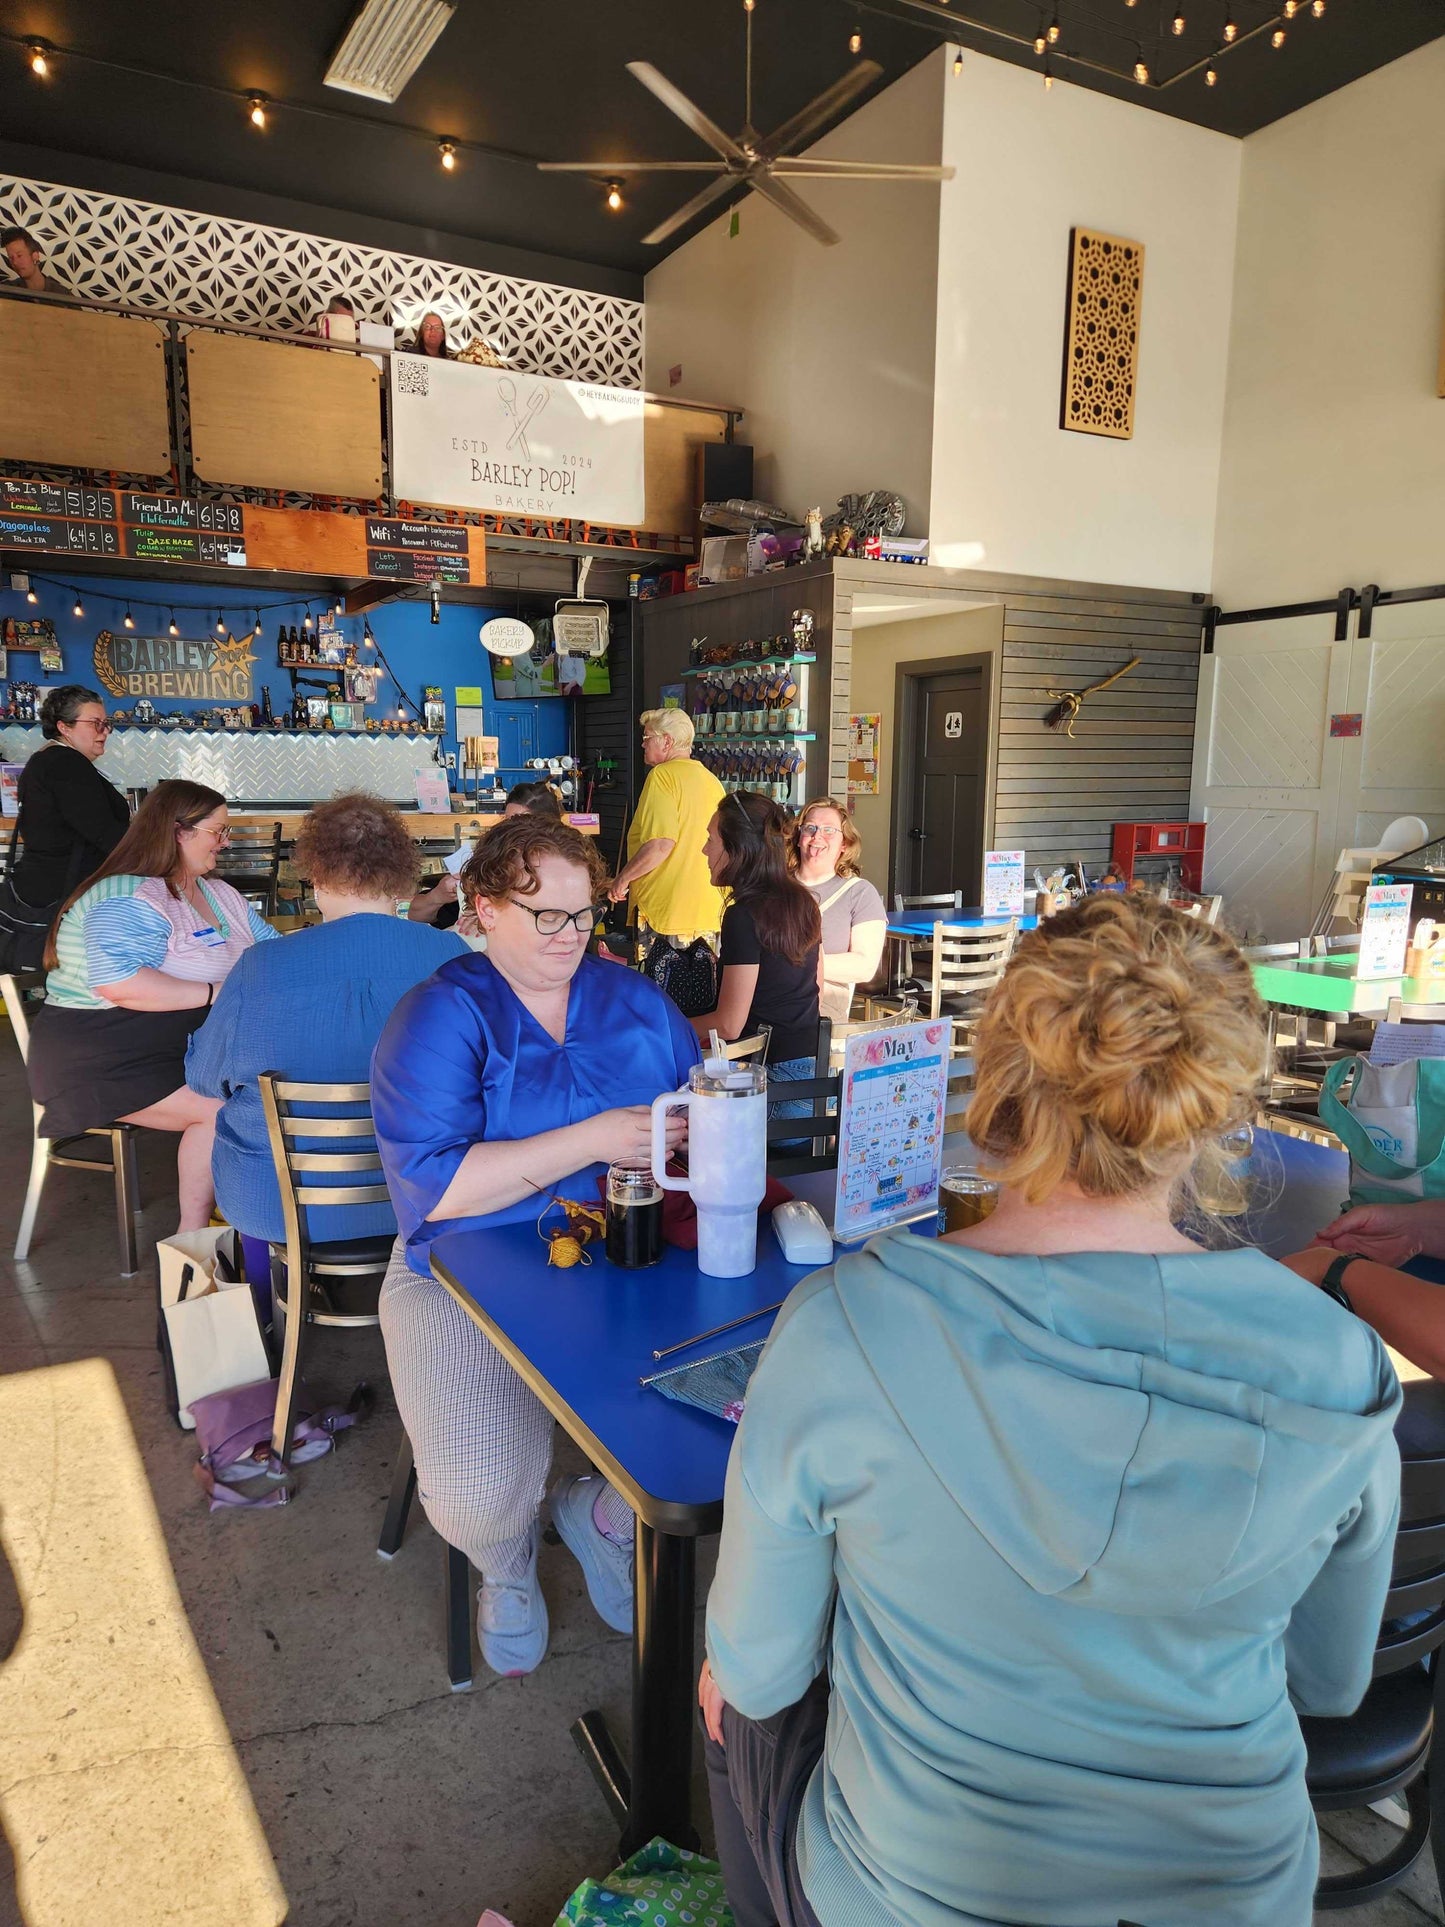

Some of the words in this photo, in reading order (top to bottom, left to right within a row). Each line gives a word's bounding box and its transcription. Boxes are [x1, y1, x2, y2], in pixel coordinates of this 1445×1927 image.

[452, 437, 488, 454] ESTD
[562, 454, 593, 469] 2024
[471, 458, 532, 488] BARLEY
[540, 467, 576, 495] POP!
[5, 482, 20, 492] Pen
[23, 482, 37, 494] Is
[40, 483, 61, 495] Blue
[67, 491, 80, 507] 5
[86, 495, 97, 511] 3
[101, 497, 113, 512] 5
[131, 495, 161, 512] Friend
[164, 499, 178, 514] In
[495, 494, 554, 512] BAKERY
[200, 505, 211, 523] 6
[215, 508, 227, 522] 5
[229, 508, 239, 526] 8
[88, 532, 96, 542] 5
[104, 532, 114, 543] 8
[172, 538, 193, 546] HAZE
[489, 624, 525, 636] BAKERY
[115, 638, 218, 672] BARLEY
[218, 644, 249, 667] POP!
[129, 671, 250, 699] BREWING
[882, 1039, 917, 1062] May
